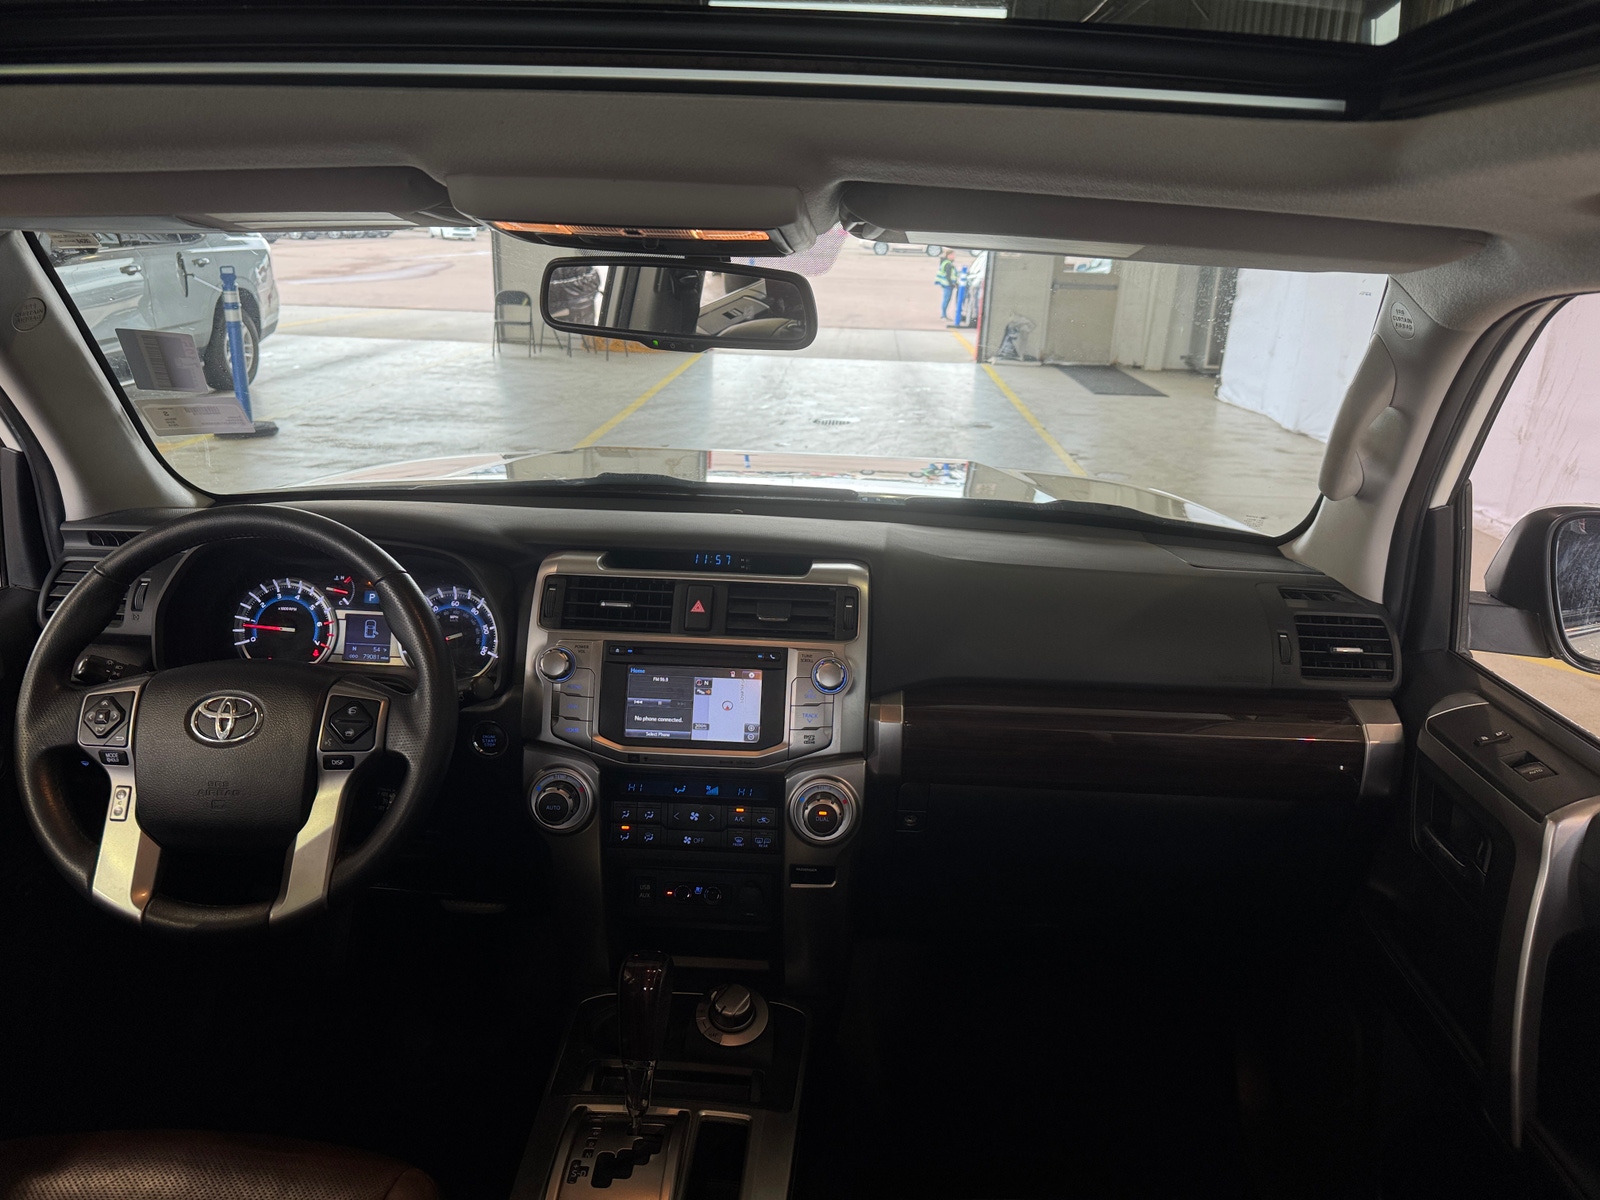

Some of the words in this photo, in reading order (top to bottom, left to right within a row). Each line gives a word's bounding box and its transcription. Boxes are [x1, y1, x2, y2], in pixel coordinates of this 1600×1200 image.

[694, 553, 732, 566] 11:57
[368, 593, 376, 602] P
[470, 608, 480, 616] 80
[482, 624, 490, 635] 100
